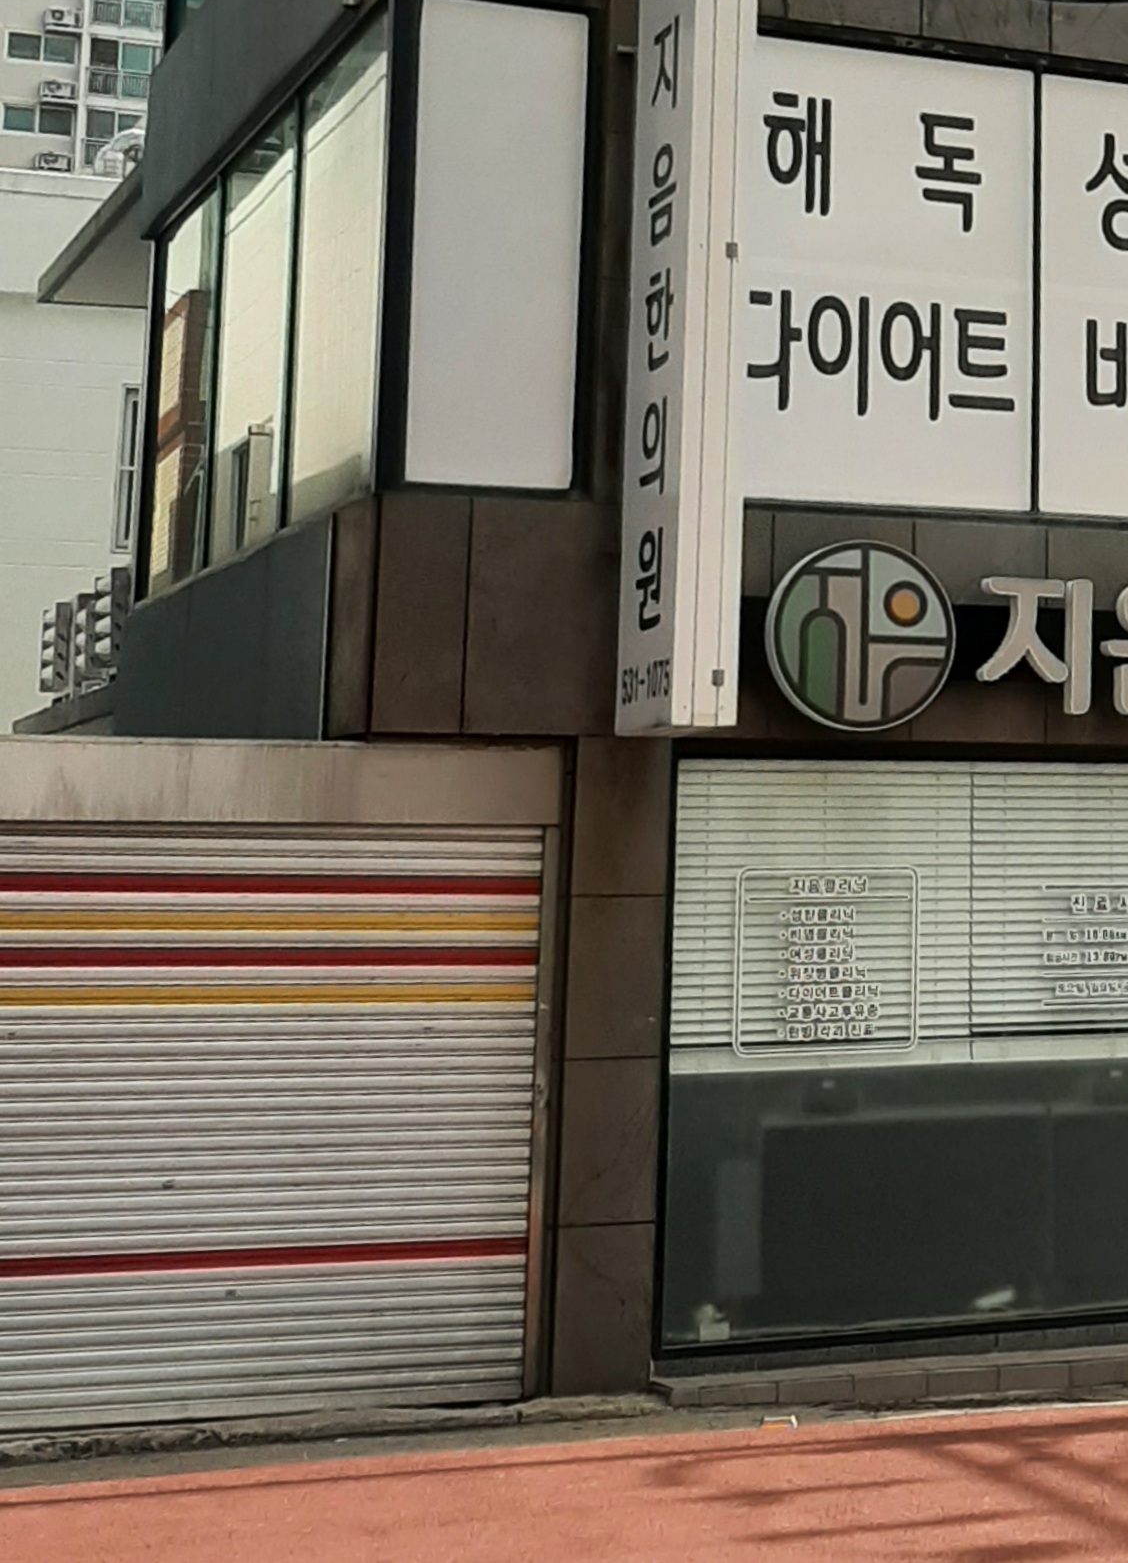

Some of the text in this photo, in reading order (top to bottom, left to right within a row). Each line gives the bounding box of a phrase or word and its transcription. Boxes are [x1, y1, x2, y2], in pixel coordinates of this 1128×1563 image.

[632, 12, 682, 633] 지음한의원
[746, 289, 1016, 422] 다이어트
[622, 659, 670, 706] 531-1075
